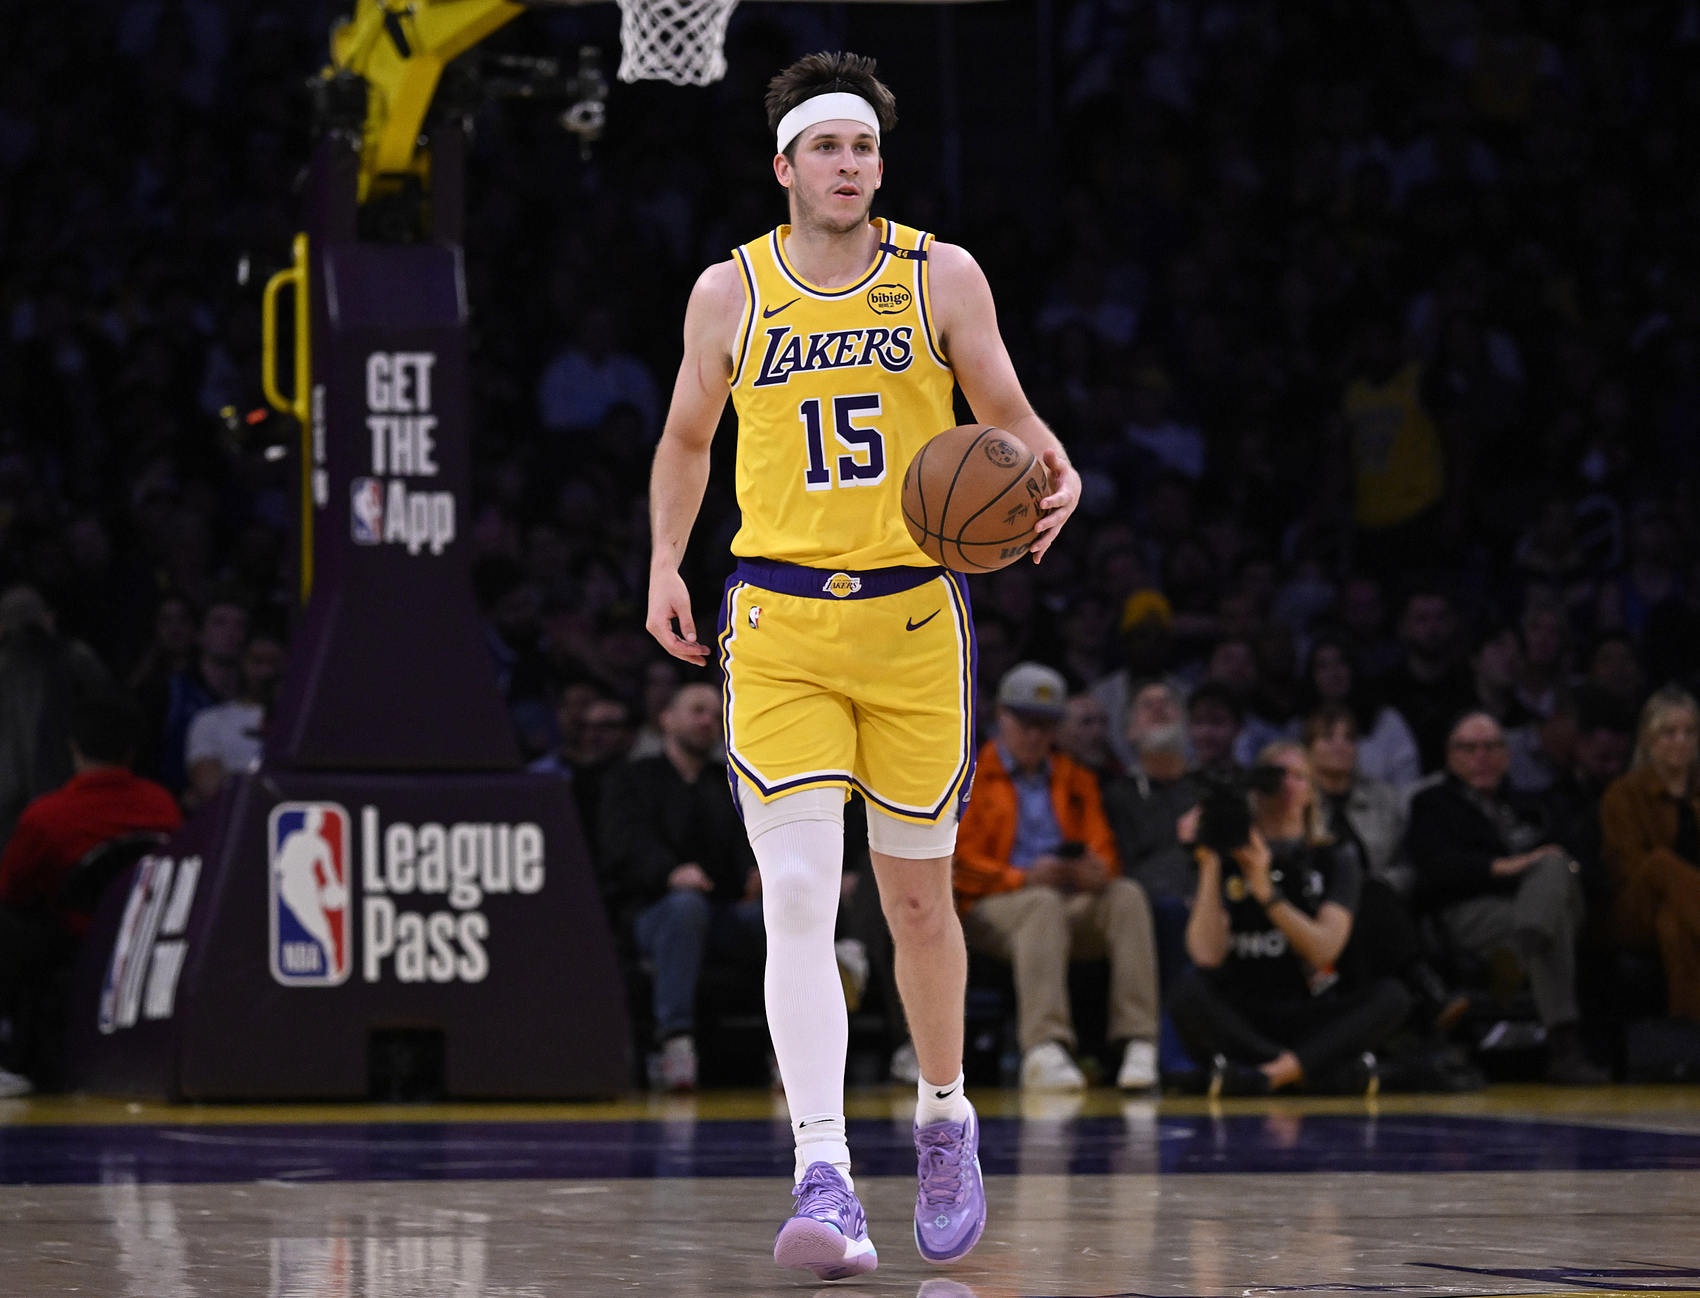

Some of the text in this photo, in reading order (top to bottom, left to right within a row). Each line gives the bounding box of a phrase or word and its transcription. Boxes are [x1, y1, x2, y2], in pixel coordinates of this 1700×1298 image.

[871, 292, 909, 305] bibigo
[366, 352, 436, 412] GET
[752, 325, 915, 388] LAKERS
[366, 415, 439, 475] THE
[798, 392, 887, 492] 15
[385, 479, 456, 555] App
[823, 577, 861, 592] LAKERS
[361, 804, 545, 909] League
[362, 895, 490, 983] Pass
